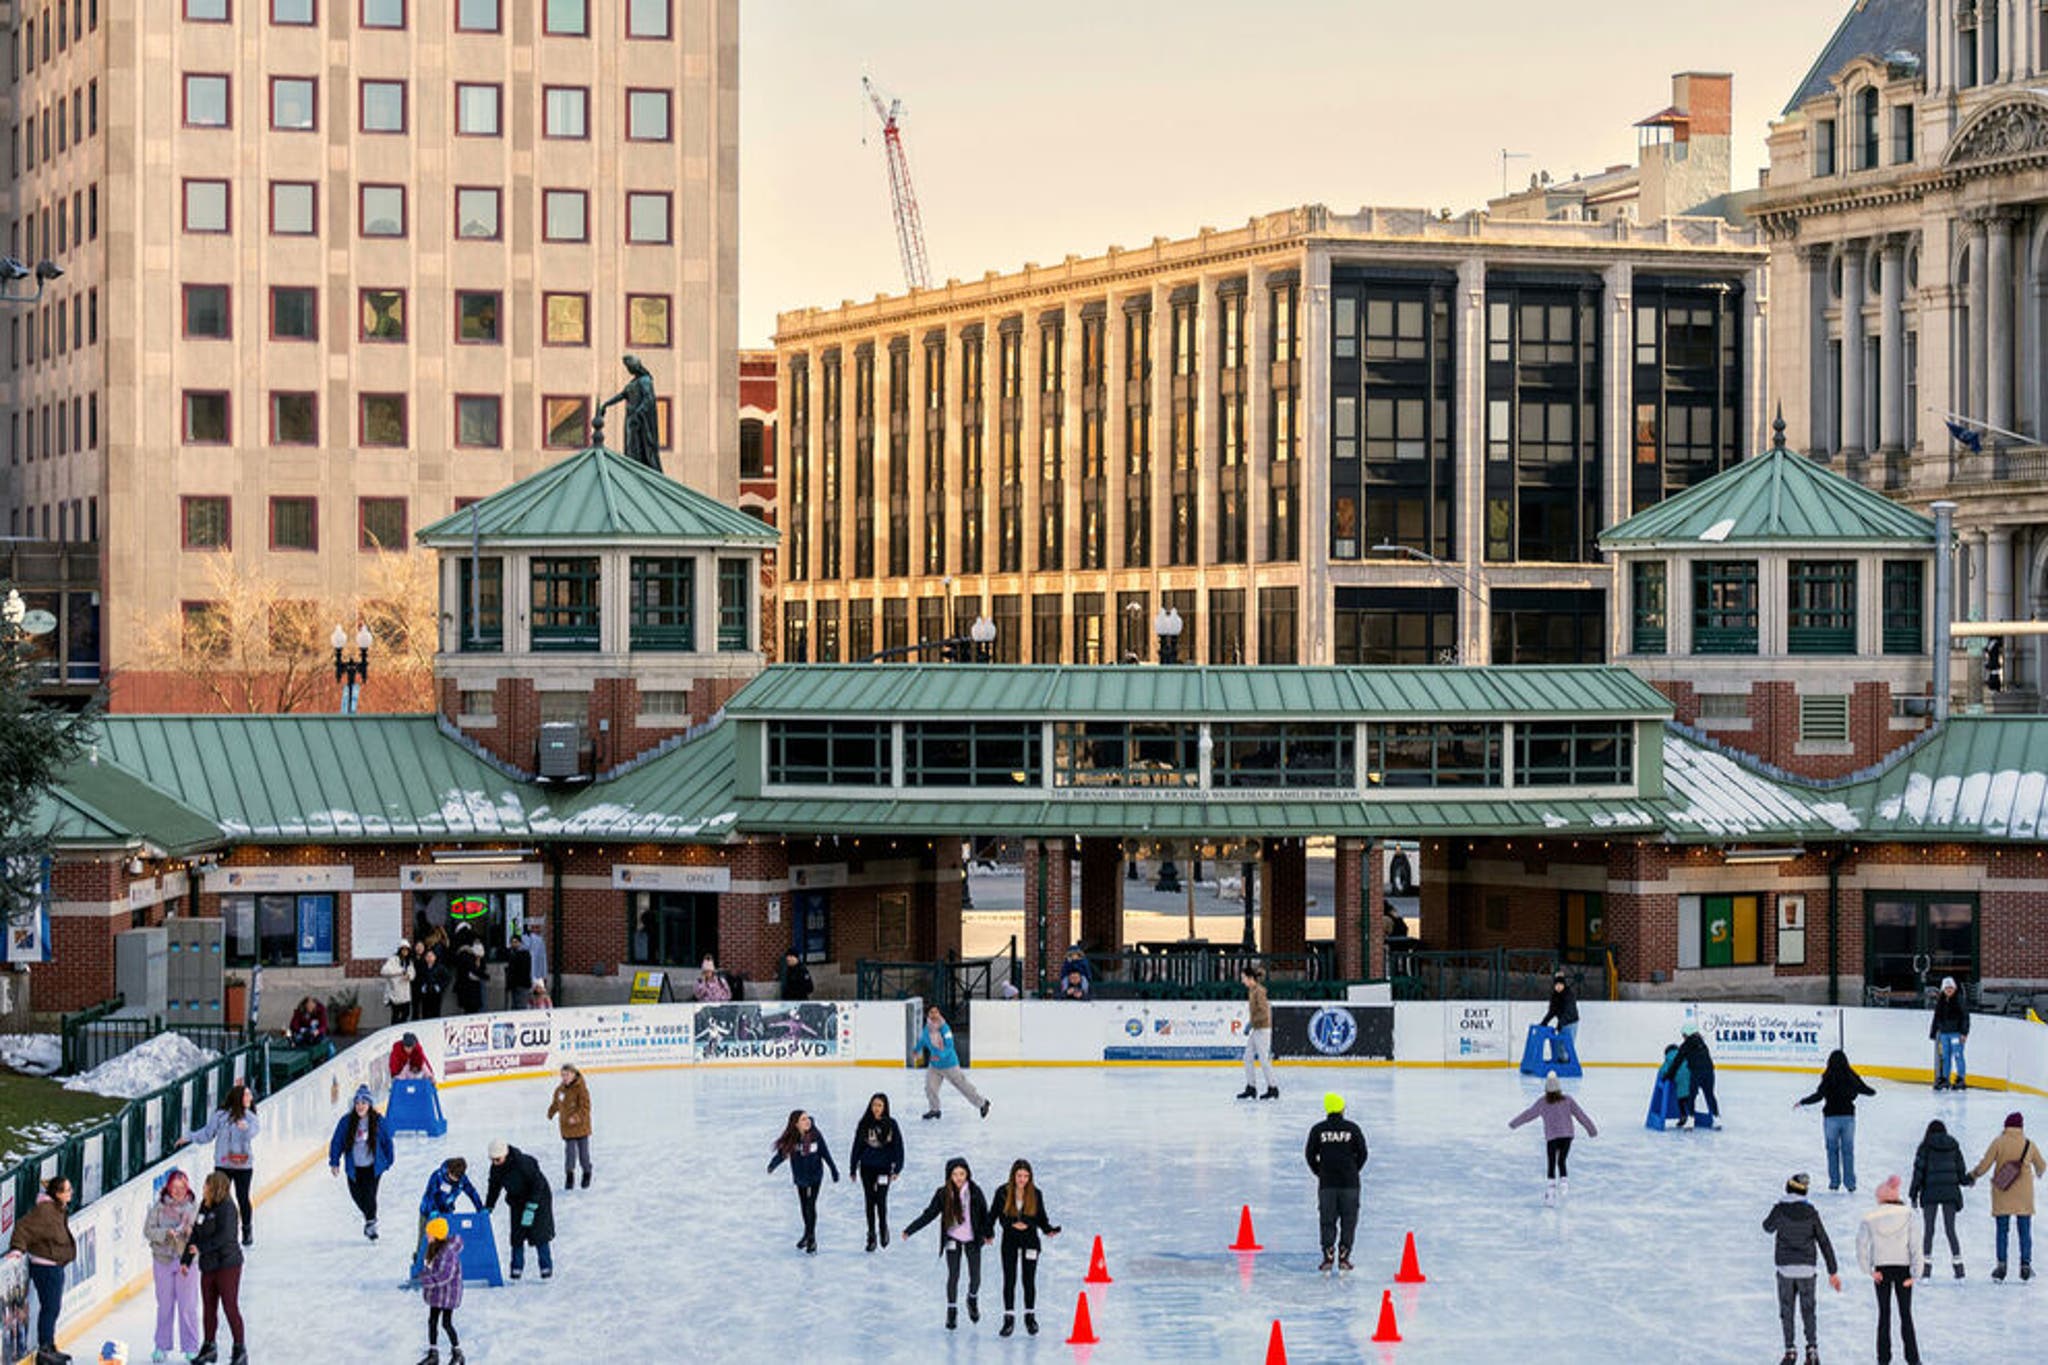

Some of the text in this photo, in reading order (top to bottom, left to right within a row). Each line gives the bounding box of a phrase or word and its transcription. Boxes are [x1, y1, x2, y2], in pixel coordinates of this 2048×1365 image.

[1463, 1008, 1489, 1018] EXIT
[1460, 1019, 1494, 1030] ONLY
[465, 1026, 488, 1043] FOX
[520, 1028, 551, 1047] CW
[1715, 1029, 1756, 1042] LEARN
[1760, 1030, 1776, 1042] TO
[1320, 1131, 1352, 1142] STAFF
